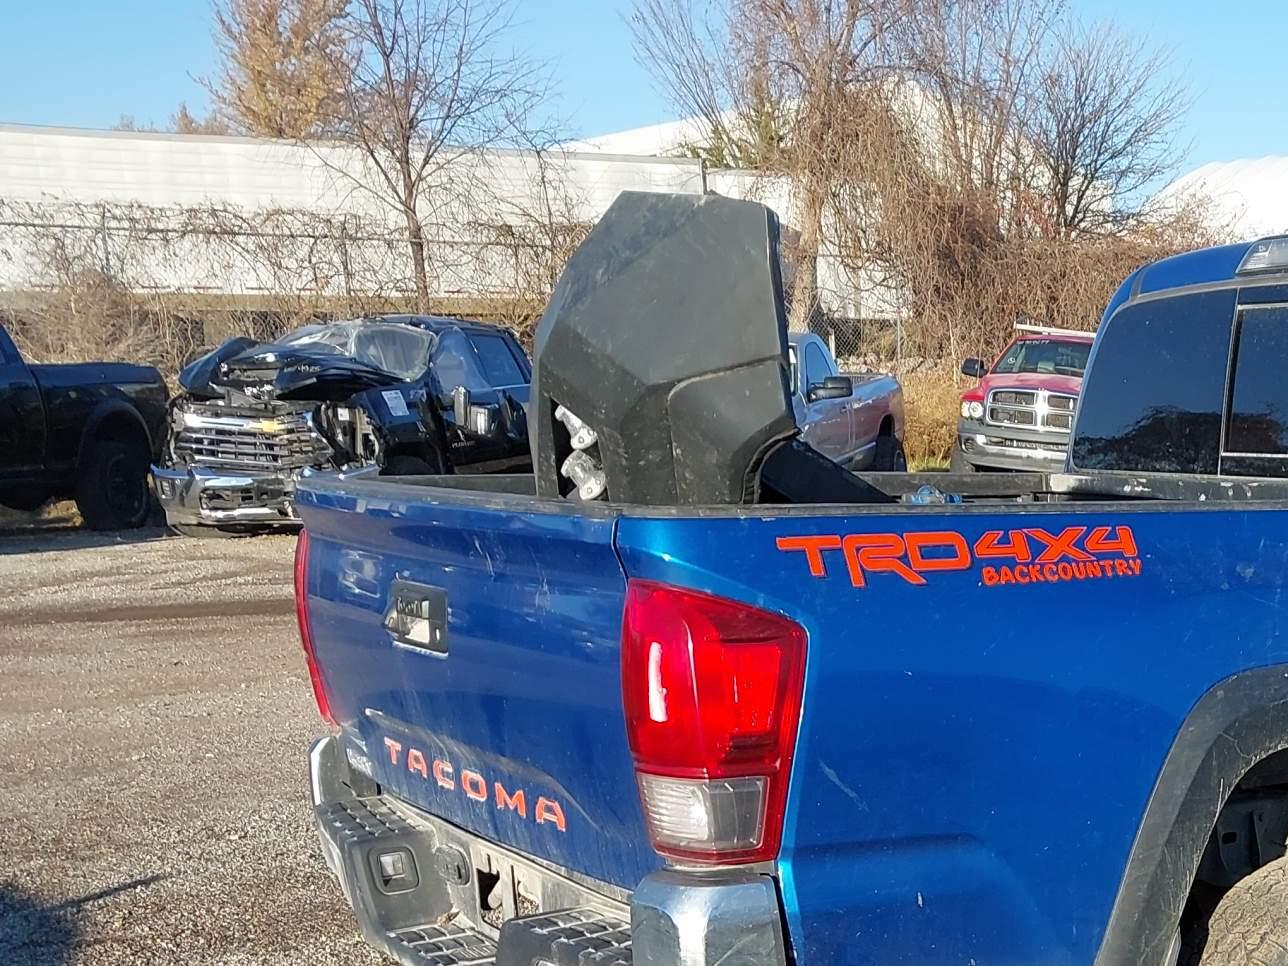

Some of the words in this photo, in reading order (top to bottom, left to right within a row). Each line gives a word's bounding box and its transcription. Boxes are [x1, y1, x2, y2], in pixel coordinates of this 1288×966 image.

[776, 531, 973, 588] TRD
[982, 558, 1142, 586] BACKCOUNTRY
[383, 736, 567, 832] TACOMA
